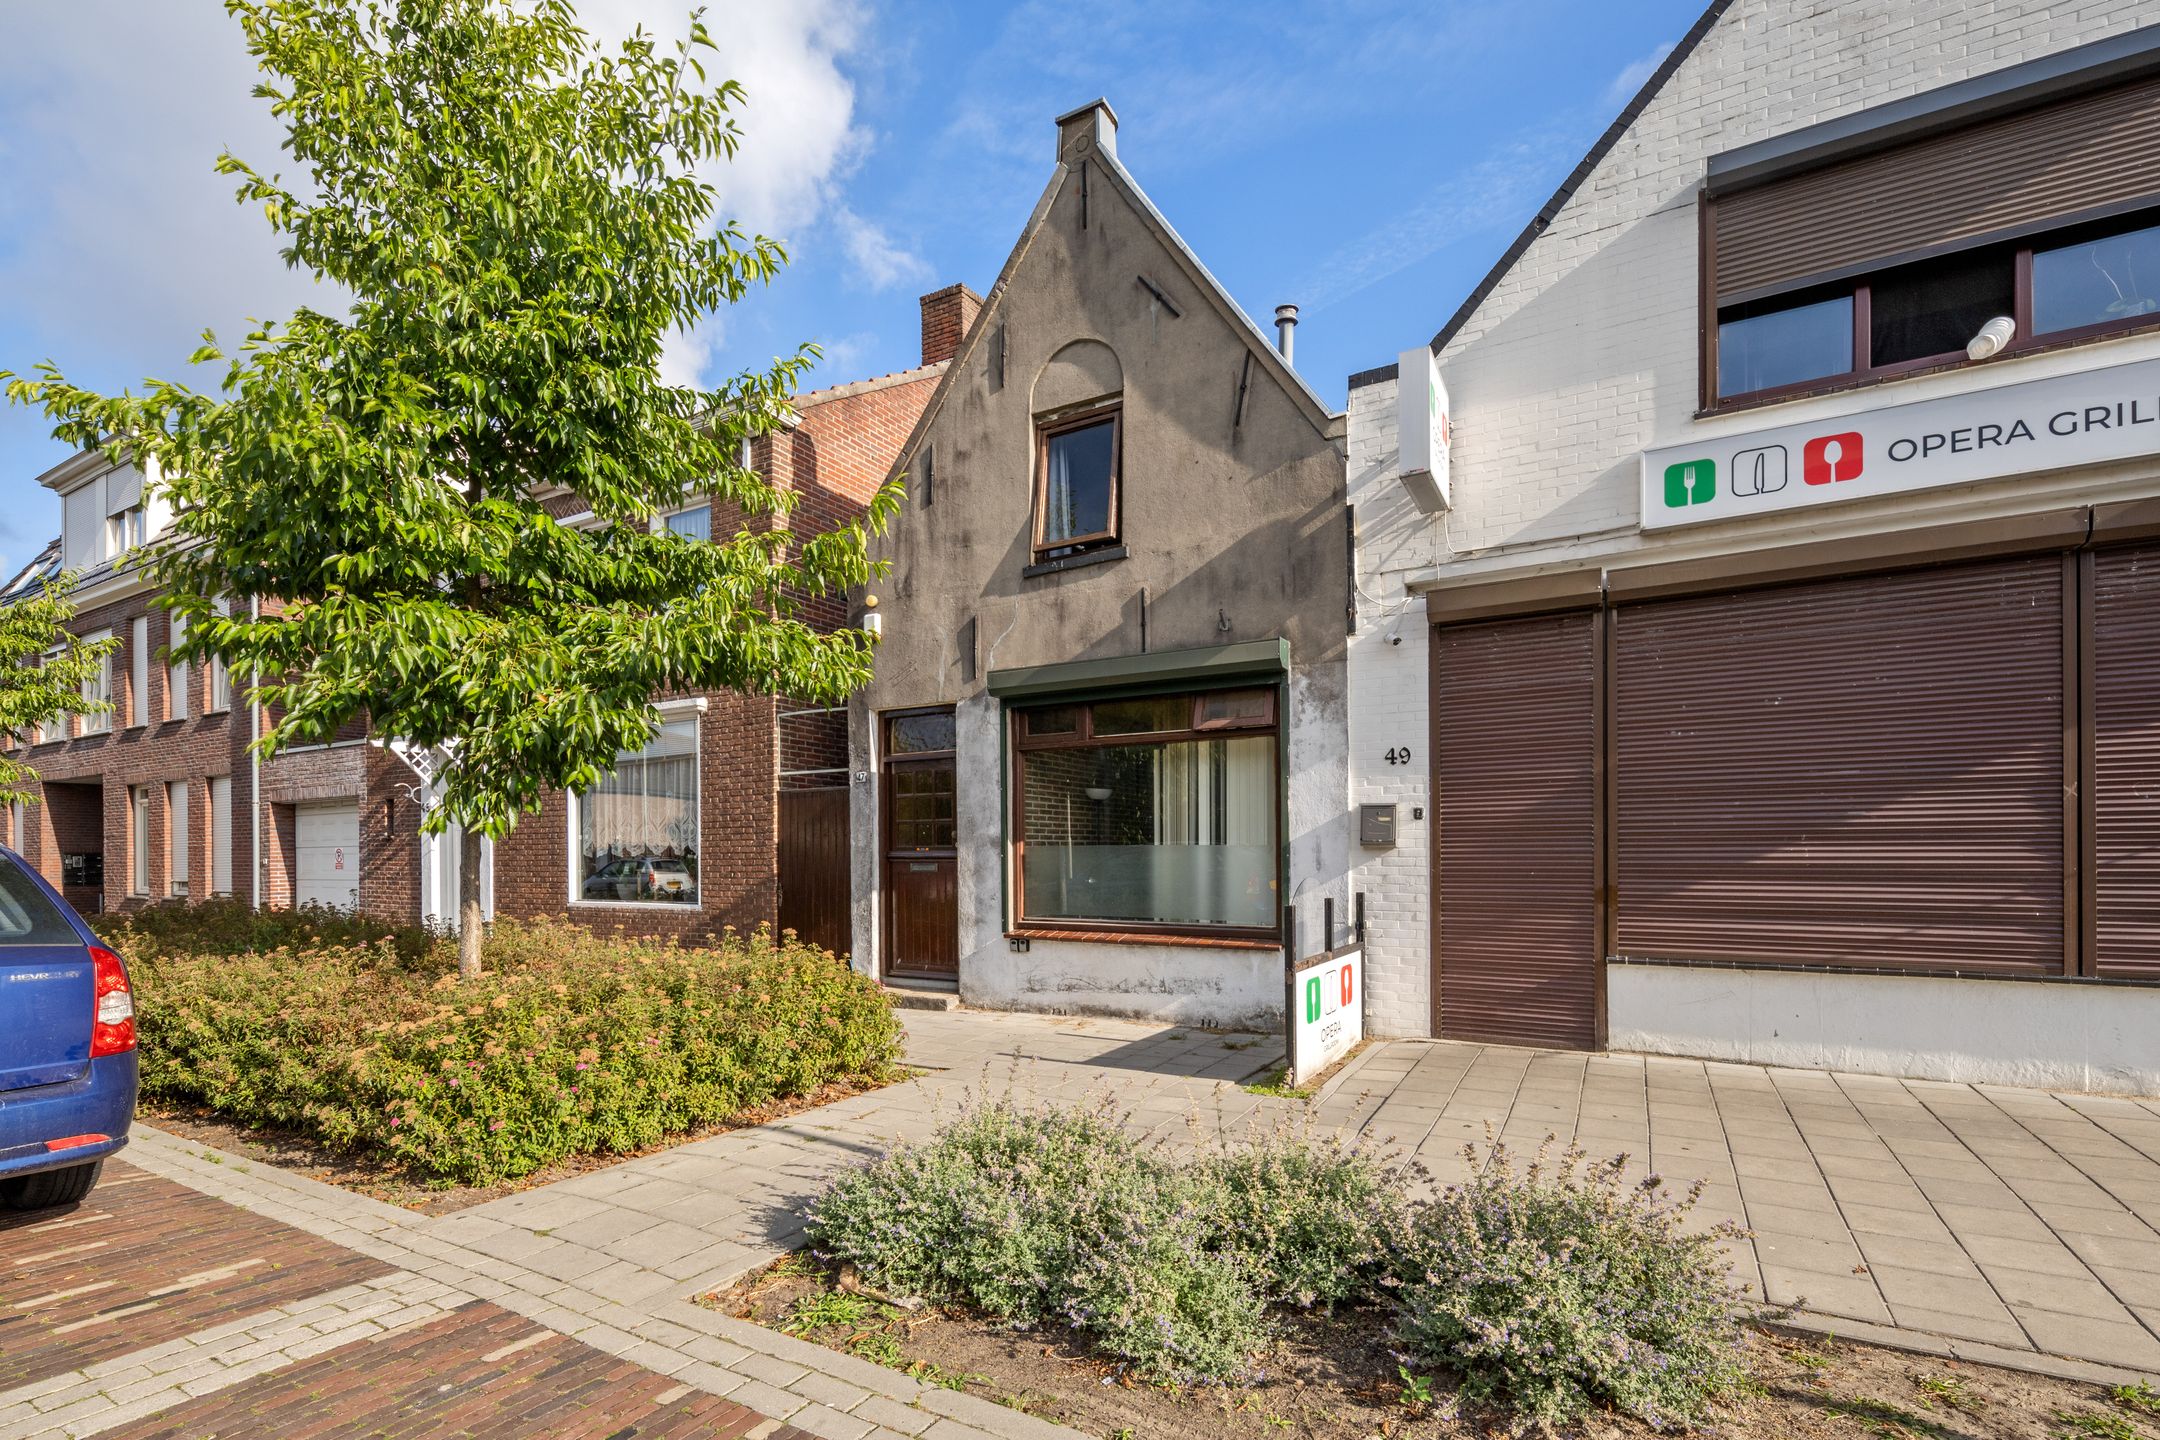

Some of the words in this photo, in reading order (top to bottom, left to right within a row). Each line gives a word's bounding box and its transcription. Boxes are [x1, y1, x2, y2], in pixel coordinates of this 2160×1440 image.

[1888, 419, 2036, 462] OPERA
[2048, 395, 2160, 436] GRIL
[1384, 746, 1411, 765] 49
[1321, 1020, 1342, 1043] OPERA
